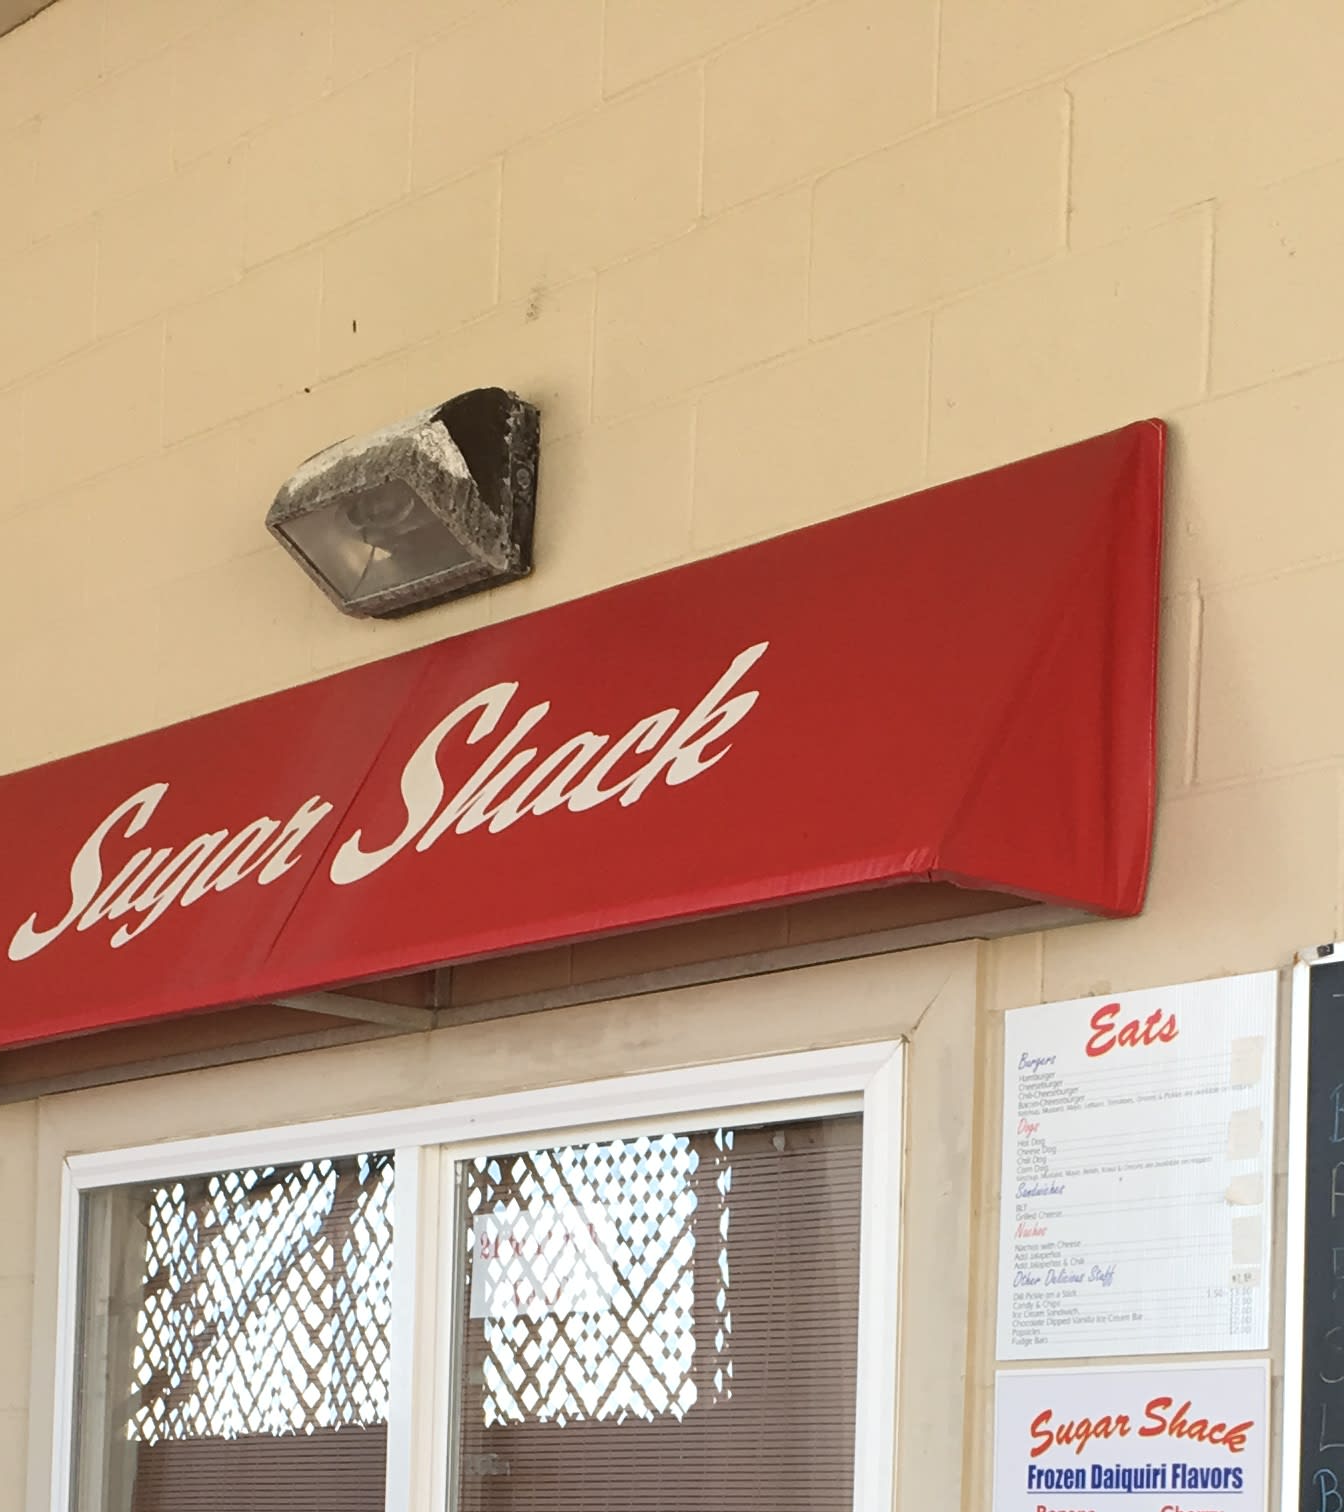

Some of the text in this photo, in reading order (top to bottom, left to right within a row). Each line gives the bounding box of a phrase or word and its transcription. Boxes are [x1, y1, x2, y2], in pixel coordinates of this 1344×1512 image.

[9, 641, 770, 963] Sugar Shack
[1085, 1002, 1179, 1058] Eats
[1017, 1052, 1056, 1073] Burgers
[1029, 1396, 1255, 1458] Sugar Shack
[1027, 1463, 1244, 1493] Frozen Daiquiri Flavors
